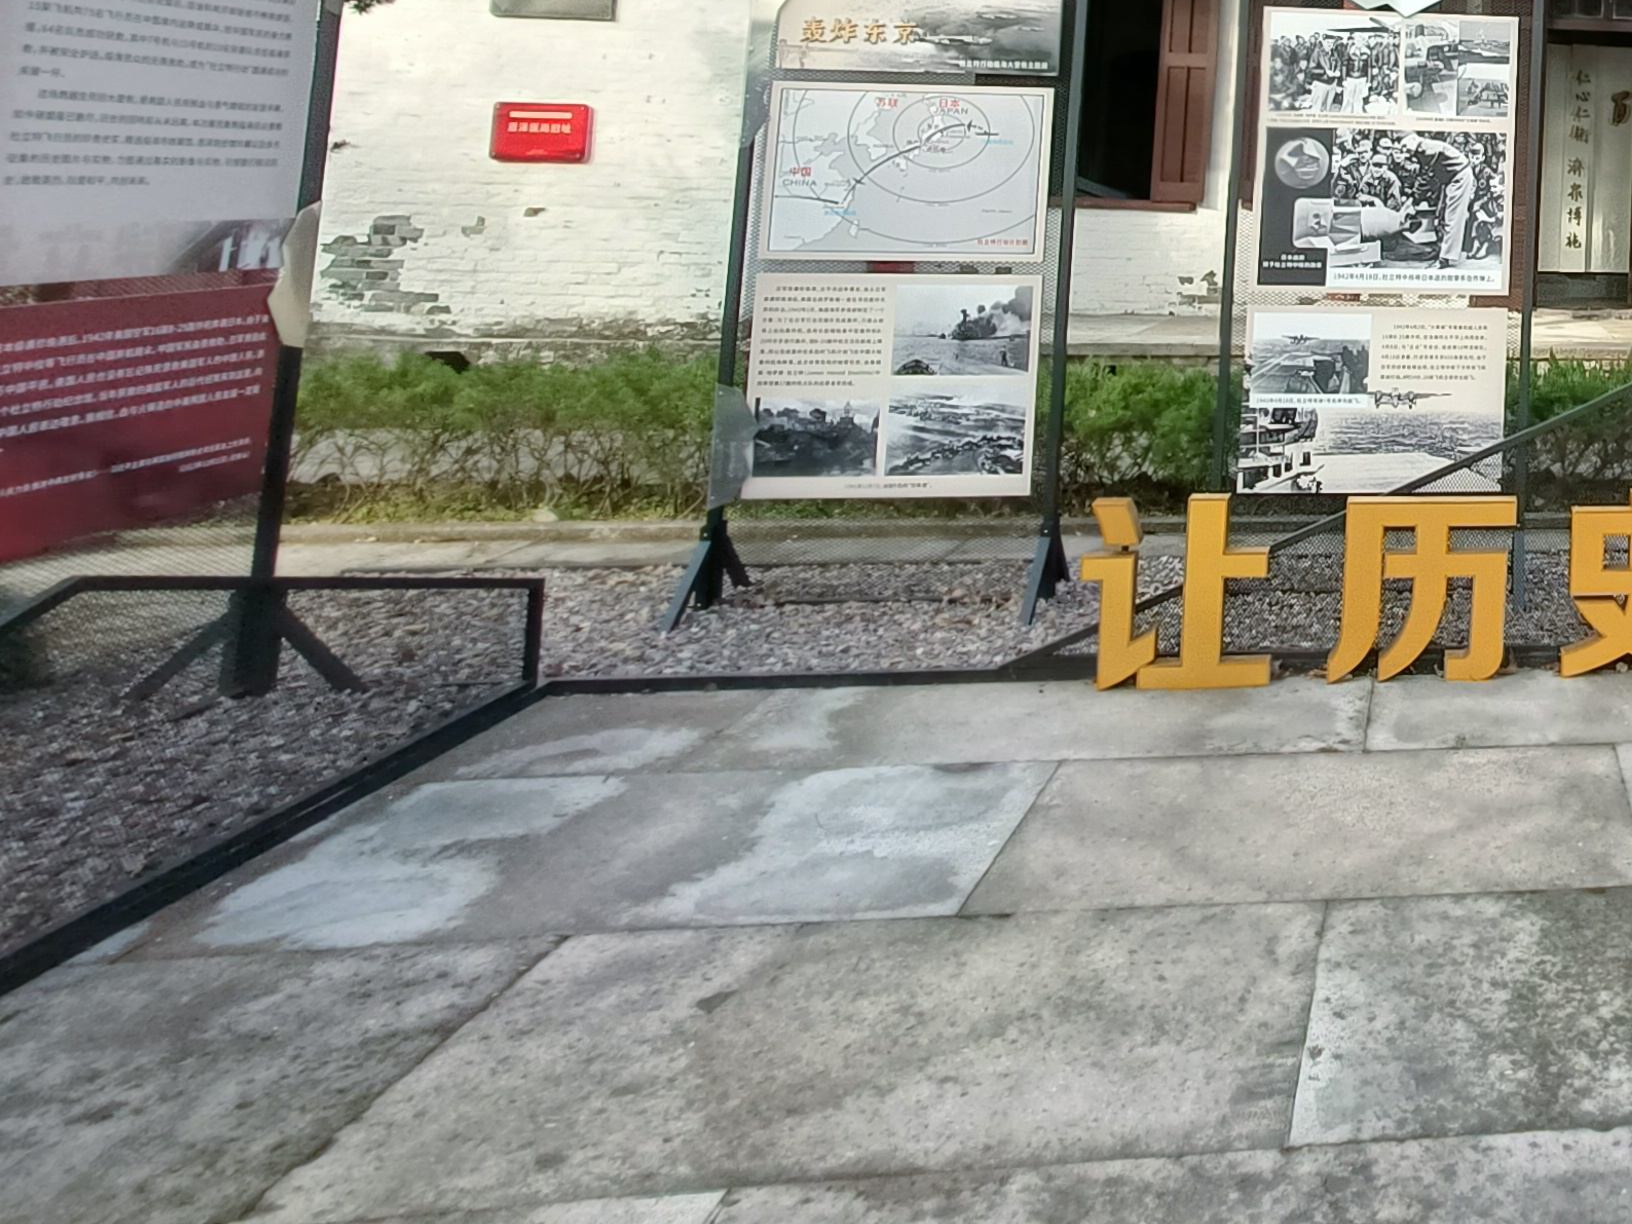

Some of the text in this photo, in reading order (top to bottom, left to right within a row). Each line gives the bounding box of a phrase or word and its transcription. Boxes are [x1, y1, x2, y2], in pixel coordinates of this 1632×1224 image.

[800, 17, 920, 45] 轰炸东京
[938, 98, 961, 108] 日本
[789, 167, 812, 177] 中国
[782, 178, 817, 187] CHINA
